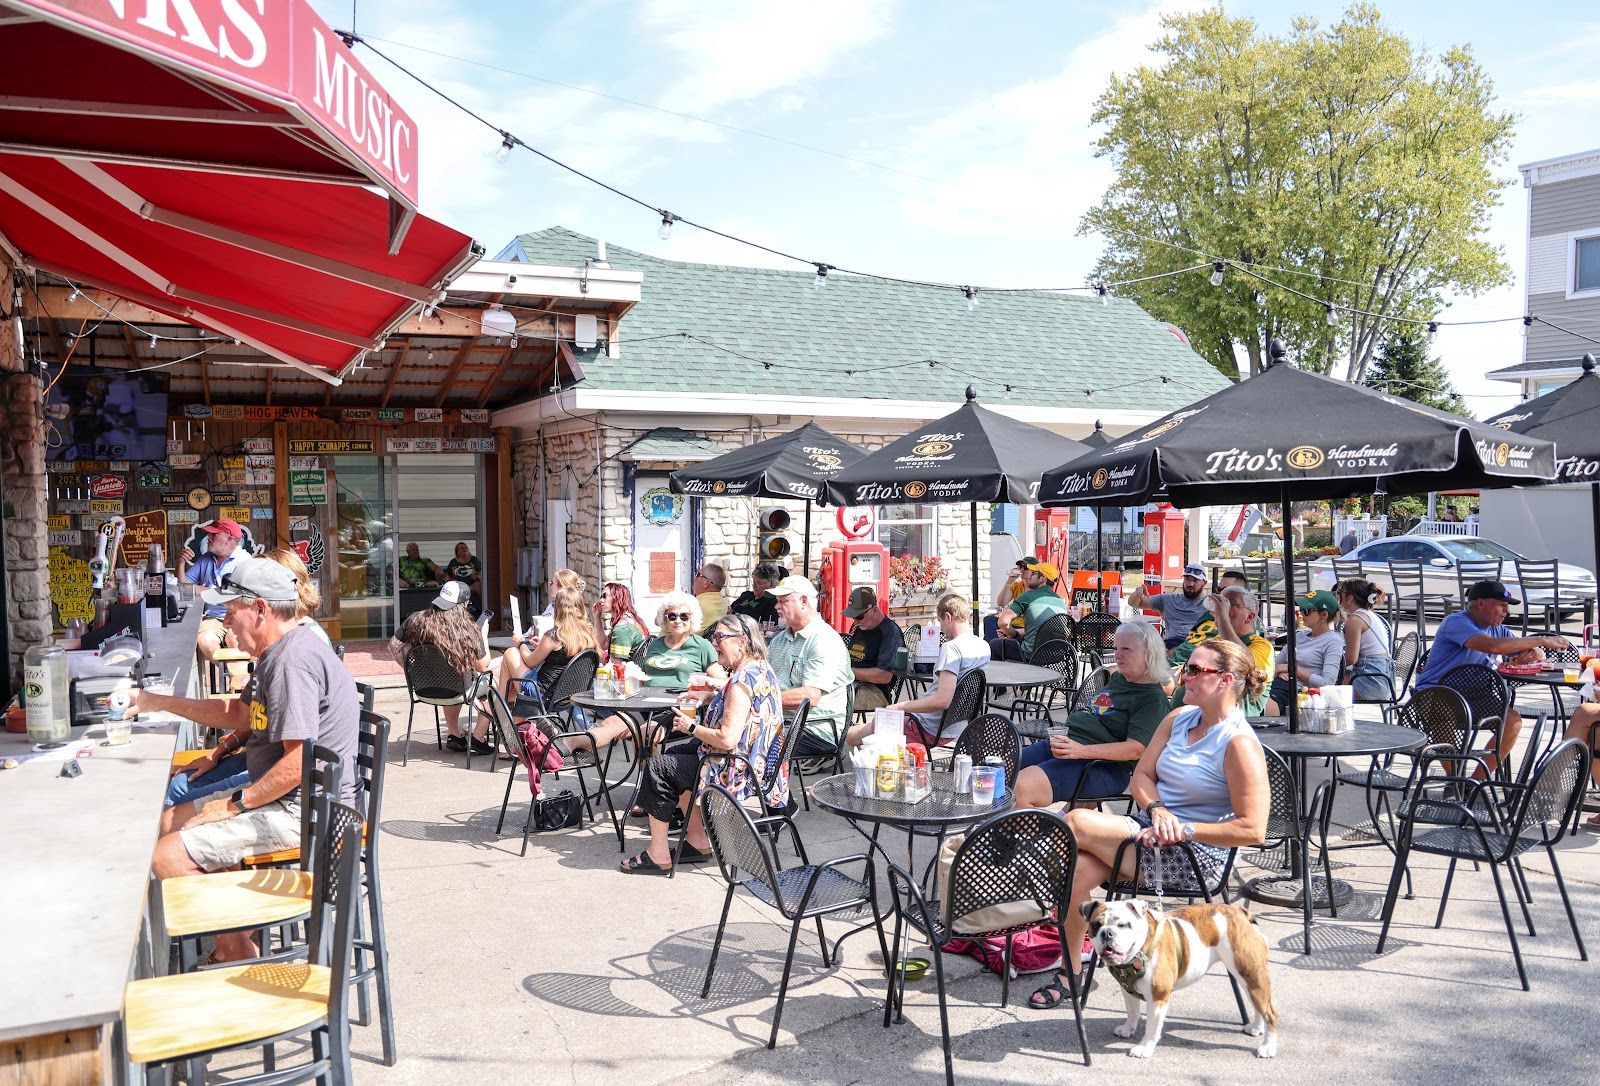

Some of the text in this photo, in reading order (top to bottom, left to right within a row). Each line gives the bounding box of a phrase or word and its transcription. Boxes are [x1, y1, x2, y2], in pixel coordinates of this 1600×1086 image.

[103, 0, 267, 68] KS
[313, 27, 411, 184] MUSIC
[249, 407, 315, 418] HOG HEAVEN
[294, 441, 315, 451] HAPPY
[318, 441, 350, 451] SCHNAPPS
[1327, 442, 1399, 460] Handmade
[1336, 457, 1388, 468] VODKA
[1510, 459, 1528, 469] VODKA
[1108, 463, 1137, 480] Handmade
[928, 479, 969, 491] Handmade
[1110, 478, 1128, 488] VODKA
[933, 489, 962, 497] VODKA
[146, 527, 165, 536] Class
